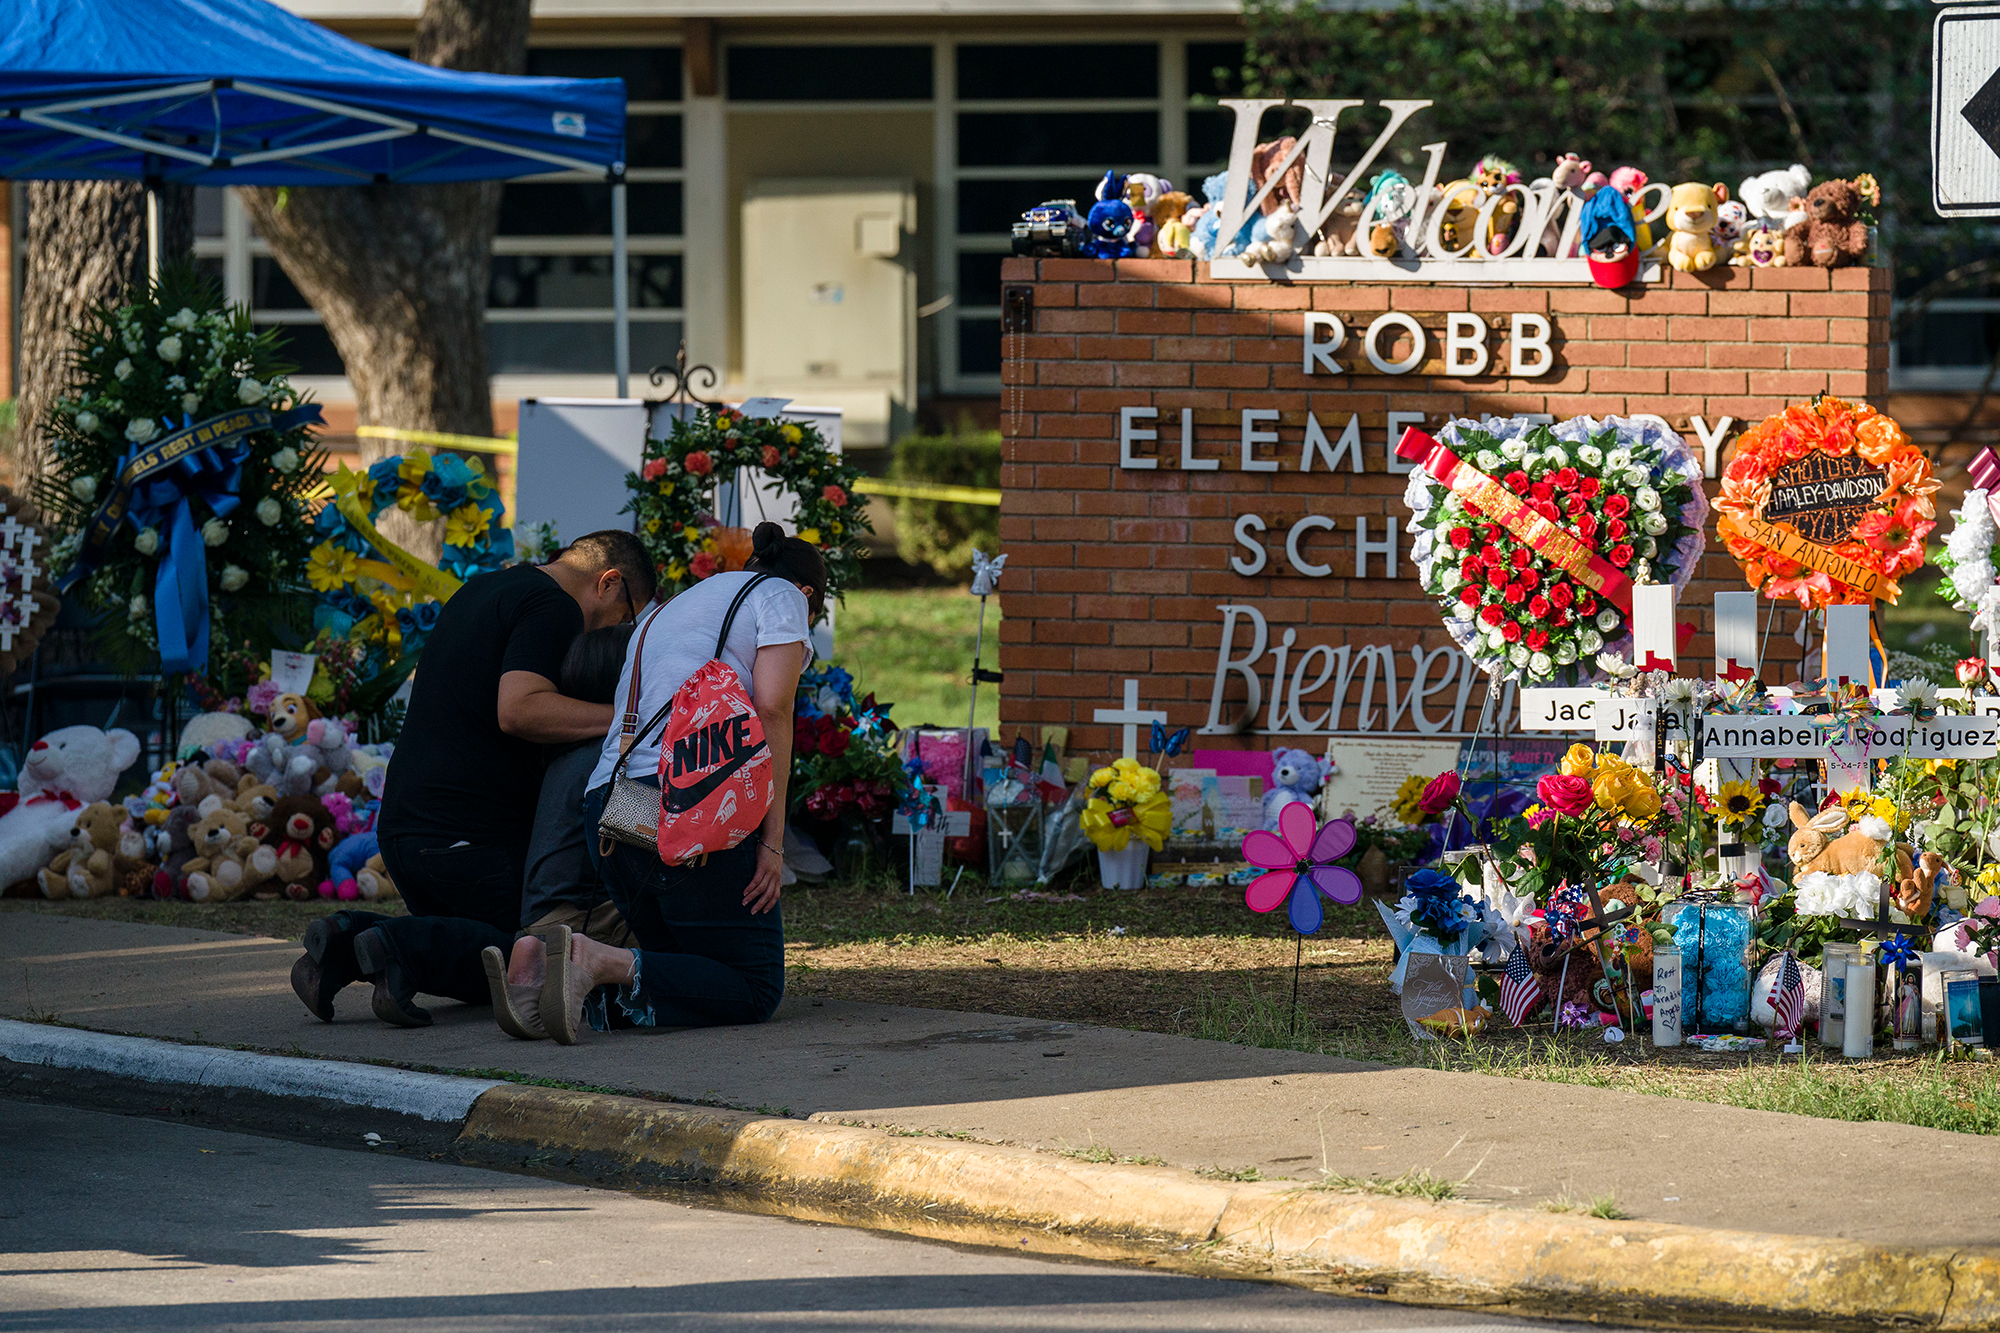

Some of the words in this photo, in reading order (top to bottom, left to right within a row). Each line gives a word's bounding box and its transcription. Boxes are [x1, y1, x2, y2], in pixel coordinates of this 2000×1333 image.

[1303, 311, 1554, 377] ROBB
[159, 433, 197, 462] REST
[198, 425, 214, 443] IN
[211, 410, 254, 438] PEACE
[1119, 406, 1733, 479] ELEMEY
[1231, 513, 1398, 579] SCH
[1505, 516, 1541, 547] SAN
[1541, 538, 1606, 592] ANTONIO
[1743, 519, 1788, 551] SAN
[1791, 542, 1878, 592] ANTONIO
[1202, 604, 1594, 735] Bienveni
[1545, 700, 1591, 722] Jac
[1855, 726, 1996, 751] Rodriguez
[672, 712, 752, 779] NIKE
[1830, 761, 1868, 769] 5-24-22
[1406, 989, 1454, 1011] Sympathy
[1412, 979, 1445, 994] With
[1657, 966, 1677, 980] Rest
